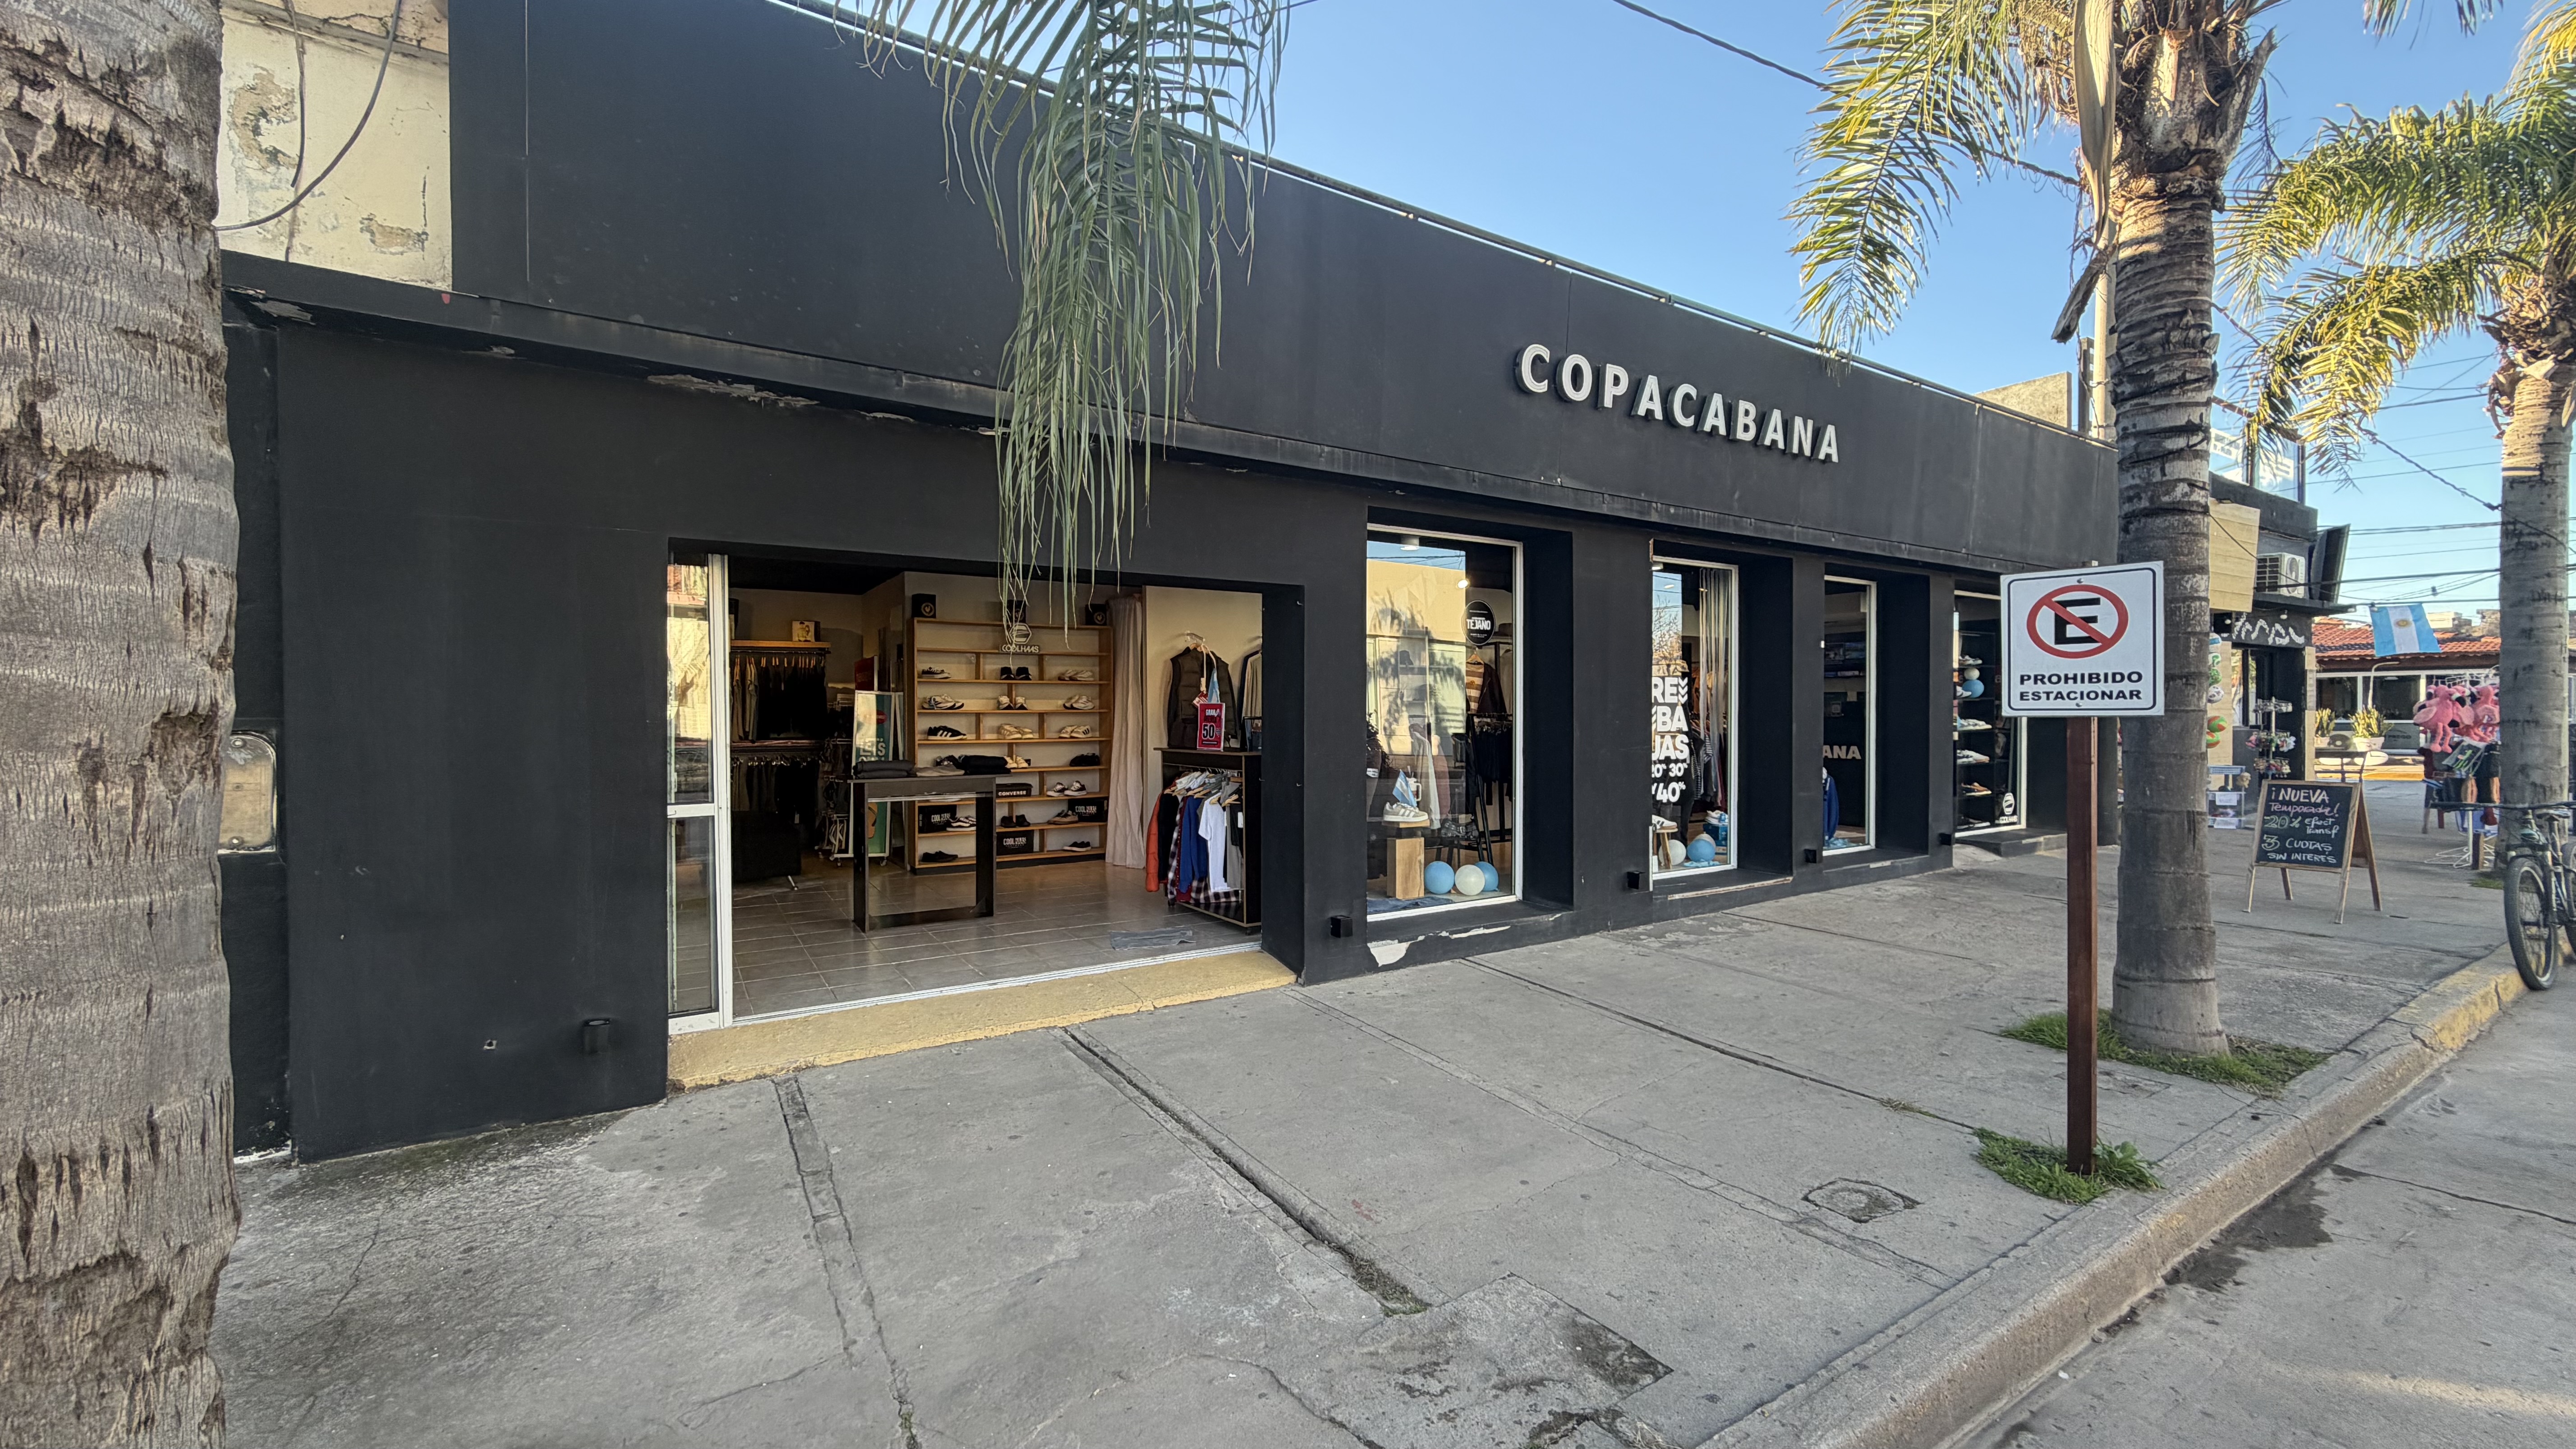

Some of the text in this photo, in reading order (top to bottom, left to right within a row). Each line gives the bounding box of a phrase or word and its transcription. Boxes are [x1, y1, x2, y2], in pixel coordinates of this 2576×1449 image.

[1517, 344, 1839, 463] COPACABANA
[1466, 619, 1491, 630] TEJANO
[1002, 644, 1039, 653] COOLHAAS
[2020, 671, 2143, 685] PROHIBIDO
[1652, 677, 1679, 703] RE
[2019, 690, 2142, 701] ESTACIONAR
[1657, 706, 1688, 731] BA
[1202, 723, 1215, 740] 50
[1822, 745, 1862, 759] ANA
[1656, 782, 1686, 803] 40%
[2262, 835, 2332, 851] 3 CUOTAS
